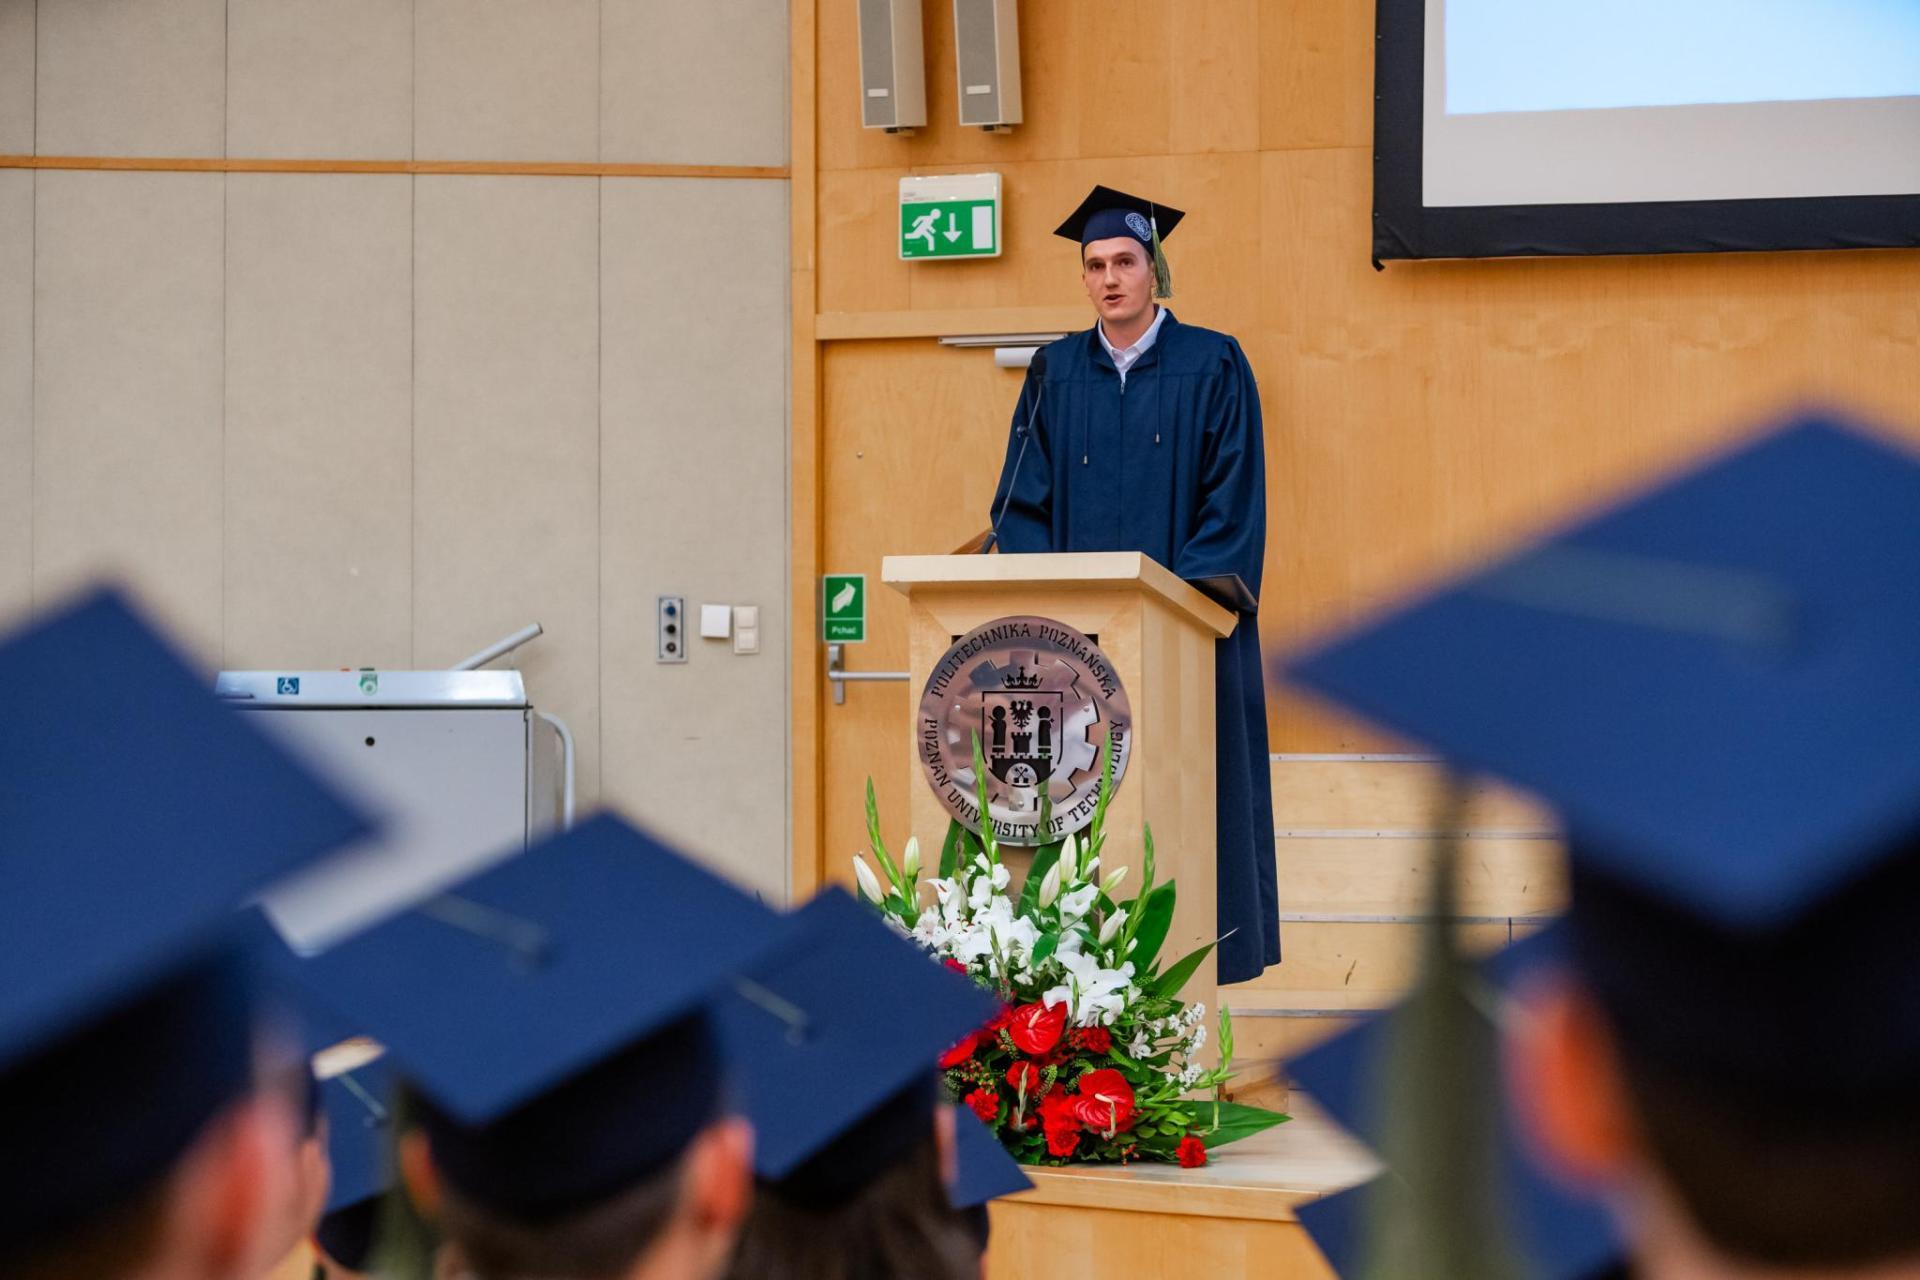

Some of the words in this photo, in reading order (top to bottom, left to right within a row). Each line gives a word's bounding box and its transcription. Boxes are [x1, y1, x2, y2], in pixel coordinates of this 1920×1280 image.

[931, 623, 1031, 698] POLITECHNIKA
[1038, 624, 1117, 699] POZNAŃSKA
[924, 718, 951, 787] POZNAN
[947, 788, 1039, 838] UNIVRSITY
